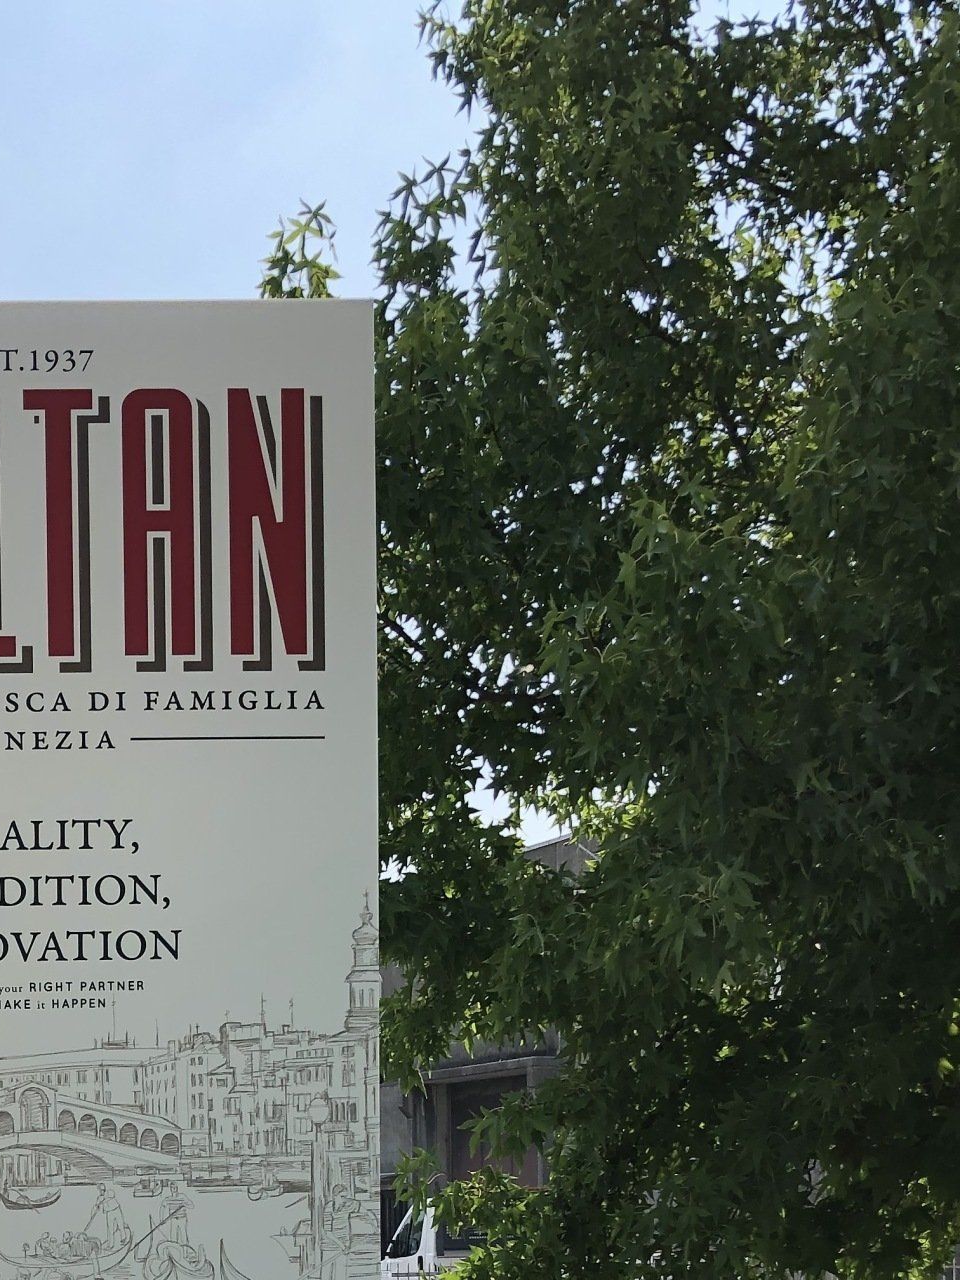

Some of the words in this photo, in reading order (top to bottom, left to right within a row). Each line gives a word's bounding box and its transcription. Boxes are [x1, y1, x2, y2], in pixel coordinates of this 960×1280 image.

[87, 691, 127, 712] DI
[143, 689, 326, 711] FAMIGLIA
[29, 981, 73, 993] RIGHT
[79, 980, 145, 992] PARTNER
[36, 1000, 46, 1010] it
[51, 997, 106, 1009] HAPPEN
